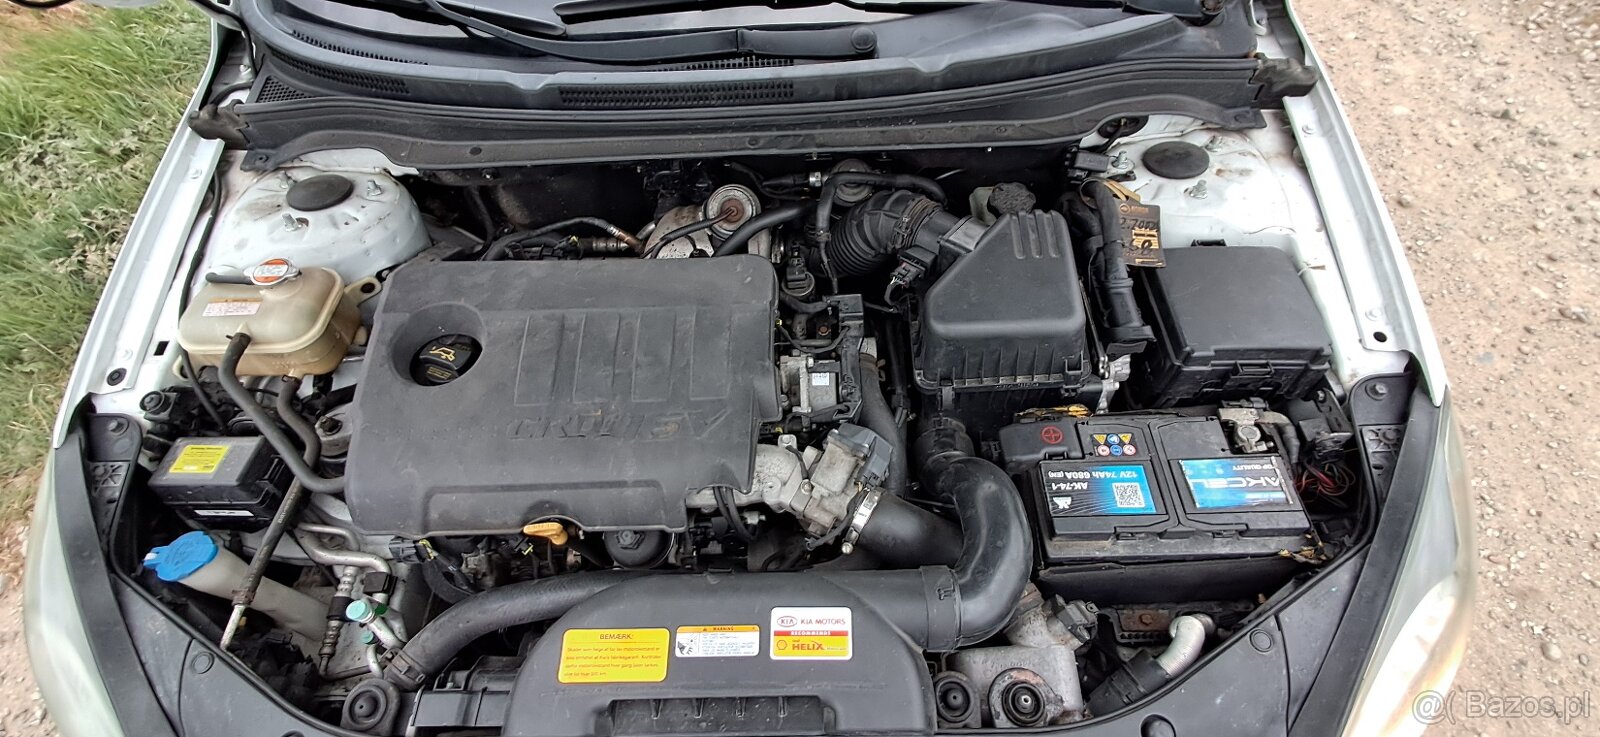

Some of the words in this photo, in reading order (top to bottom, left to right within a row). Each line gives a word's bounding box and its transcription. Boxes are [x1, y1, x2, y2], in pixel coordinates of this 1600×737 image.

[1065, 470, 1091, 479] 680A
[1092, 470, 1118, 479] 74Ah
[1120, 470, 1138, 479] 12V
[1051, 482, 1089, 491] AK-74-1
[792, 641, 825, 651] HELIX
